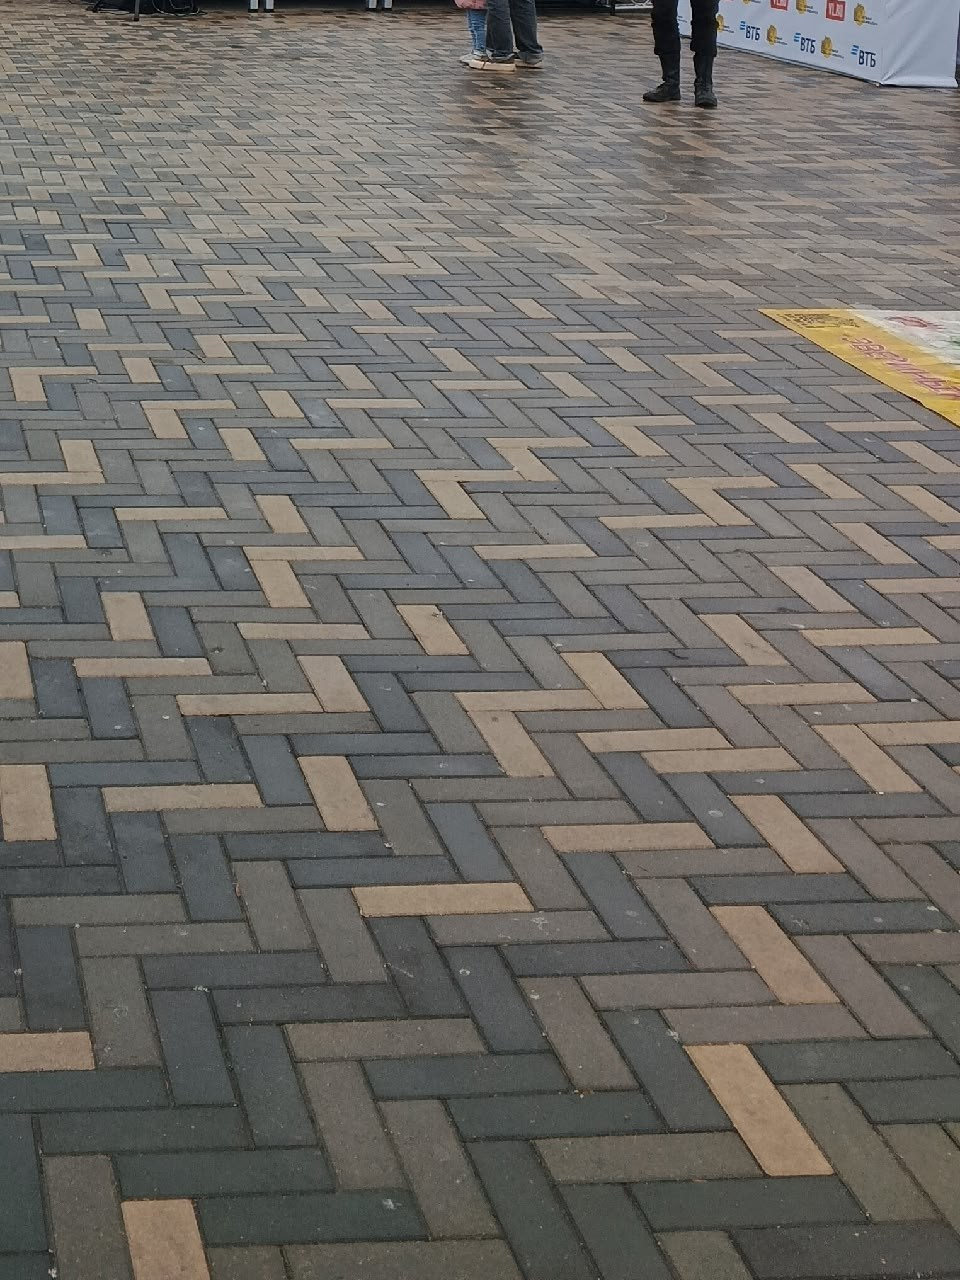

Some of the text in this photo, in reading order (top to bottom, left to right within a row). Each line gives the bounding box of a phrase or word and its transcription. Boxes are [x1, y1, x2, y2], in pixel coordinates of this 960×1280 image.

[746, 26, 761, 41] ВТБ
[800, 37, 816, 54] ВТБ
[859, 50, 876, 68] ВТБ
